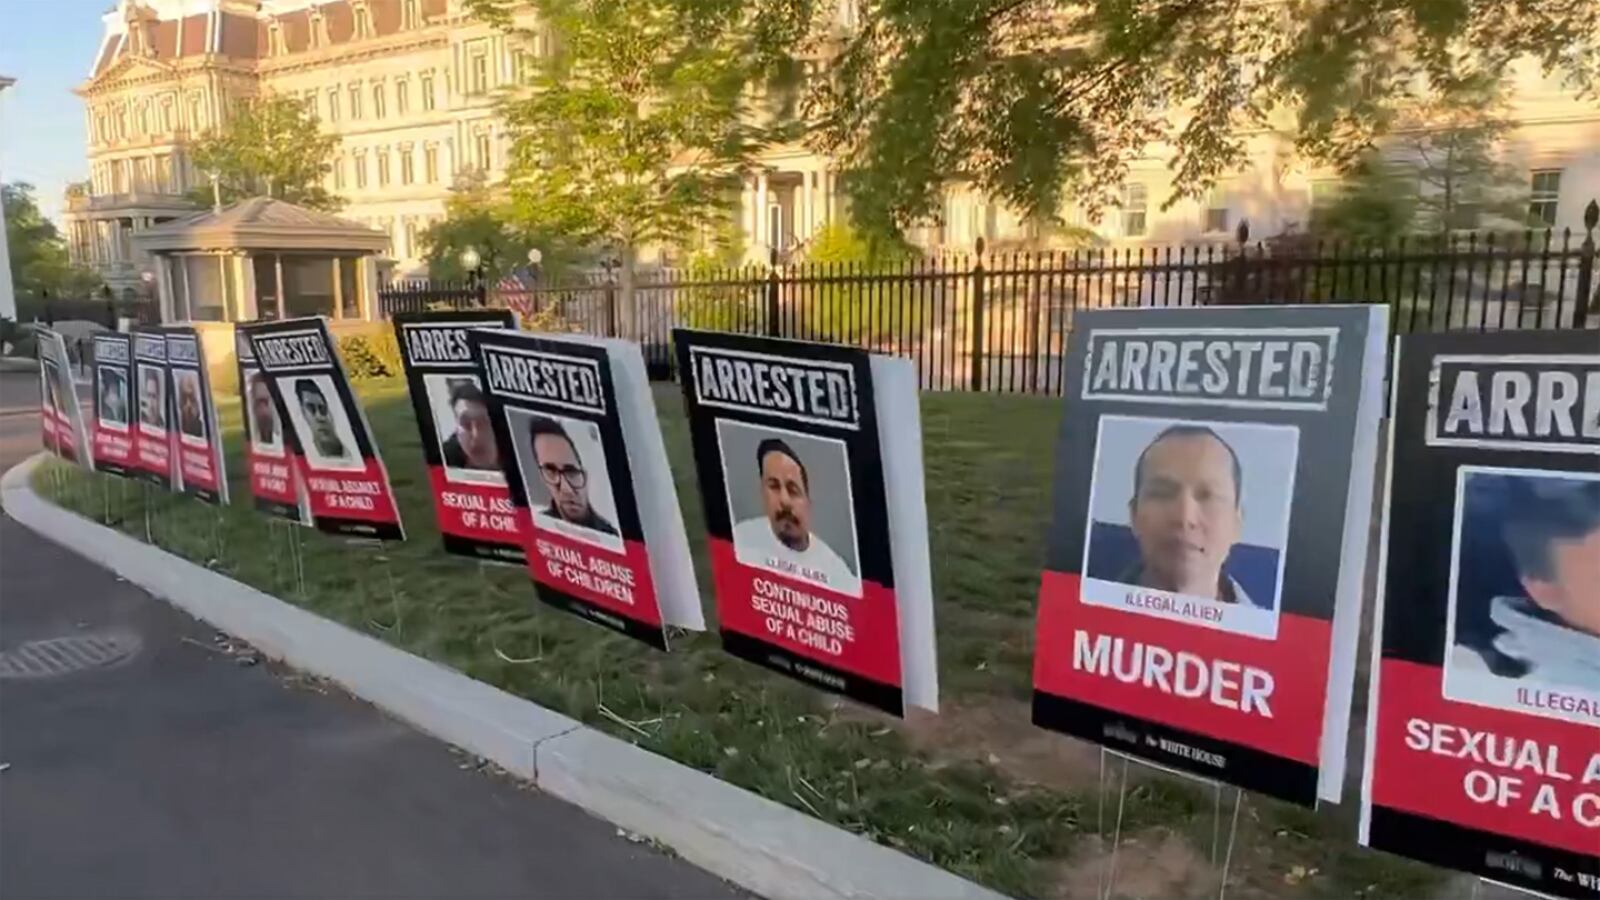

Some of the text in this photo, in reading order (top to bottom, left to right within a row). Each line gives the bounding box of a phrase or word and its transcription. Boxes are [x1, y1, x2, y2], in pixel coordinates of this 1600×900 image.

[258, 336, 329, 366] ARRESTED
[410, 329, 471, 360] ARRES
[489, 353, 599, 405] ARRESTED
[701, 356, 849, 418] ARRESTED
[1093, 340, 1323, 397] ARRESTED
[442, 491, 487, 511] SEXUAL
[463, 512, 476, 528] OF
[480, 513, 489, 529] A
[536, 539, 636, 587] SEXUAL ABUSE
[547, 559, 634, 606] OF CHILDREN
[751, 596, 855, 642] SEXUAL ABUSE
[752, 577, 848, 621] CONTINUOUS
[1125, 592, 1224, 622] ILLEGAL ALIEN
[766, 617, 842, 656] OF A CHILD
[1072, 629, 1275, 718] MURDER
[1160, 737, 1190, 759] WHITE
[1404, 717, 1573, 781] SEXUAL
[1463, 769, 1524, 808] OF
[1530, 784, 1561, 819] A
[1553, 866, 1573, 882] The
